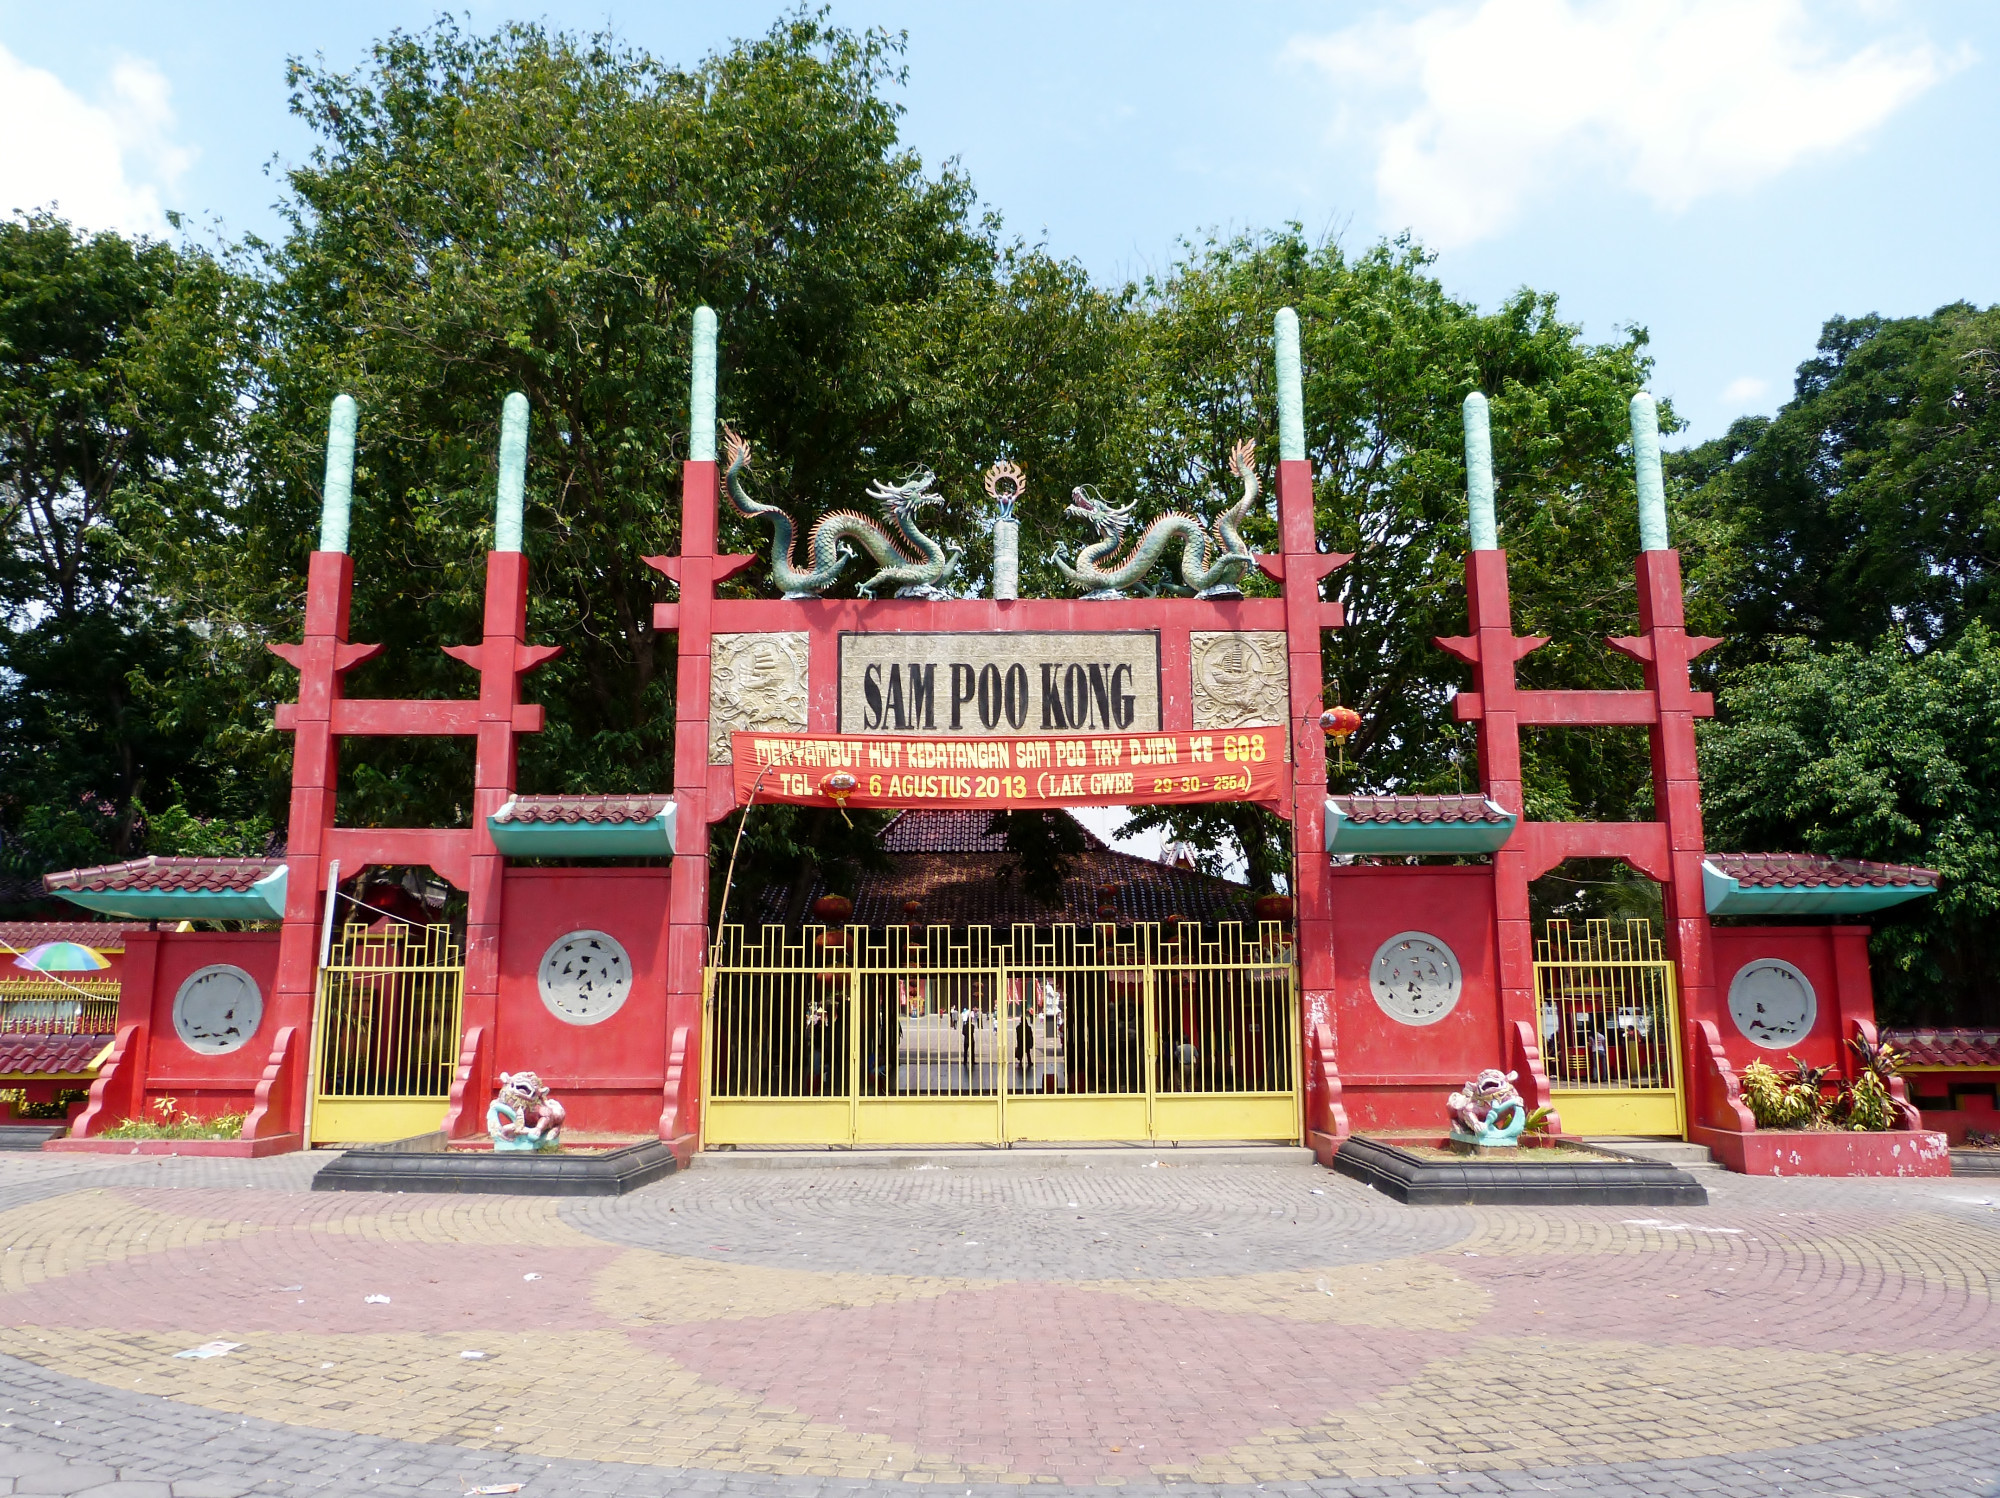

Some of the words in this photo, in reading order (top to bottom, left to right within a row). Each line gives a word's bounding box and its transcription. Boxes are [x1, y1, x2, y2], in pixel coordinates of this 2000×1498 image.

[864, 663, 937, 730] SAM
[949, 662, 1029, 730] POO
[1039, 662, 1136, 730] KONG
[754, 739, 863, 768] MENYAMBUT
[868, 741, 901, 768] HUT
[908, 741, 1009, 769] KEDATANGAN
[1016, 741, 1050, 768] SAM
[1056, 740, 1087, 767] POO
[1092, 738, 1122, 766] TAY
[1130, 737, 1177, 765] DJIEN
[1190, 736, 1213, 763] KE
[1223, 734, 1266, 763] 608
[869, 774, 882, 797] 6
[888, 775, 971, 798] AGUSTUS
[975, 775, 1027, 799] 2013
[1090, 772, 1134, 795] GWEE
